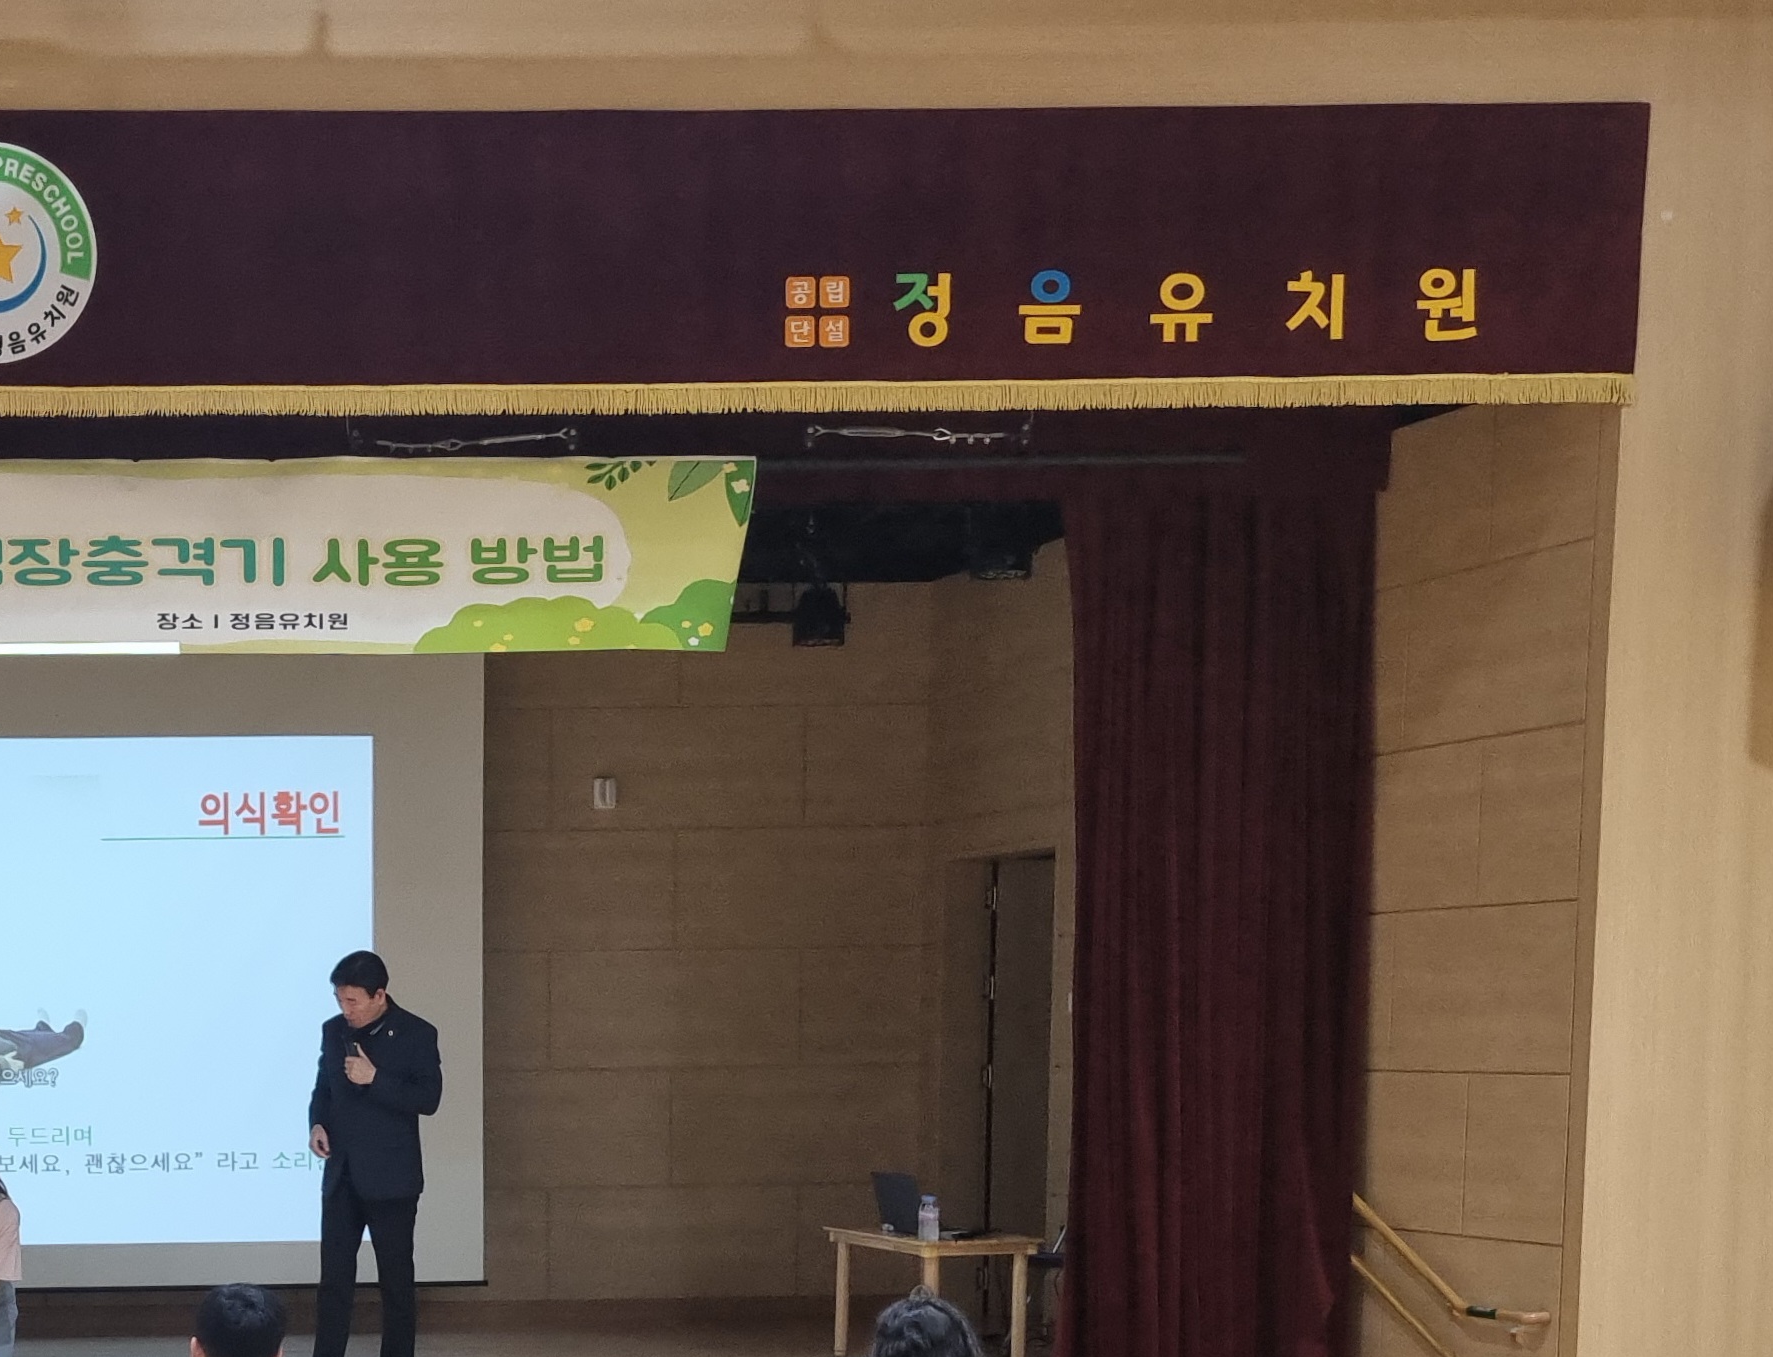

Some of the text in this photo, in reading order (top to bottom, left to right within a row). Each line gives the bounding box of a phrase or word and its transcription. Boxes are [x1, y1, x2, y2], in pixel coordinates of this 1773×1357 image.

[893, 268, 1479, 347] 정음유치원
[312, 536, 446, 587] 사용
[470, 535, 606, 584] 방법
[156, 611, 204, 631] 장소
[229, 611, 349, 631] 정음유치원
[198, 790, 340, 835] 의식확인
[7, 1125, 93, 1147] 두드리며
[216, 1151, 260, 1172] 라고
